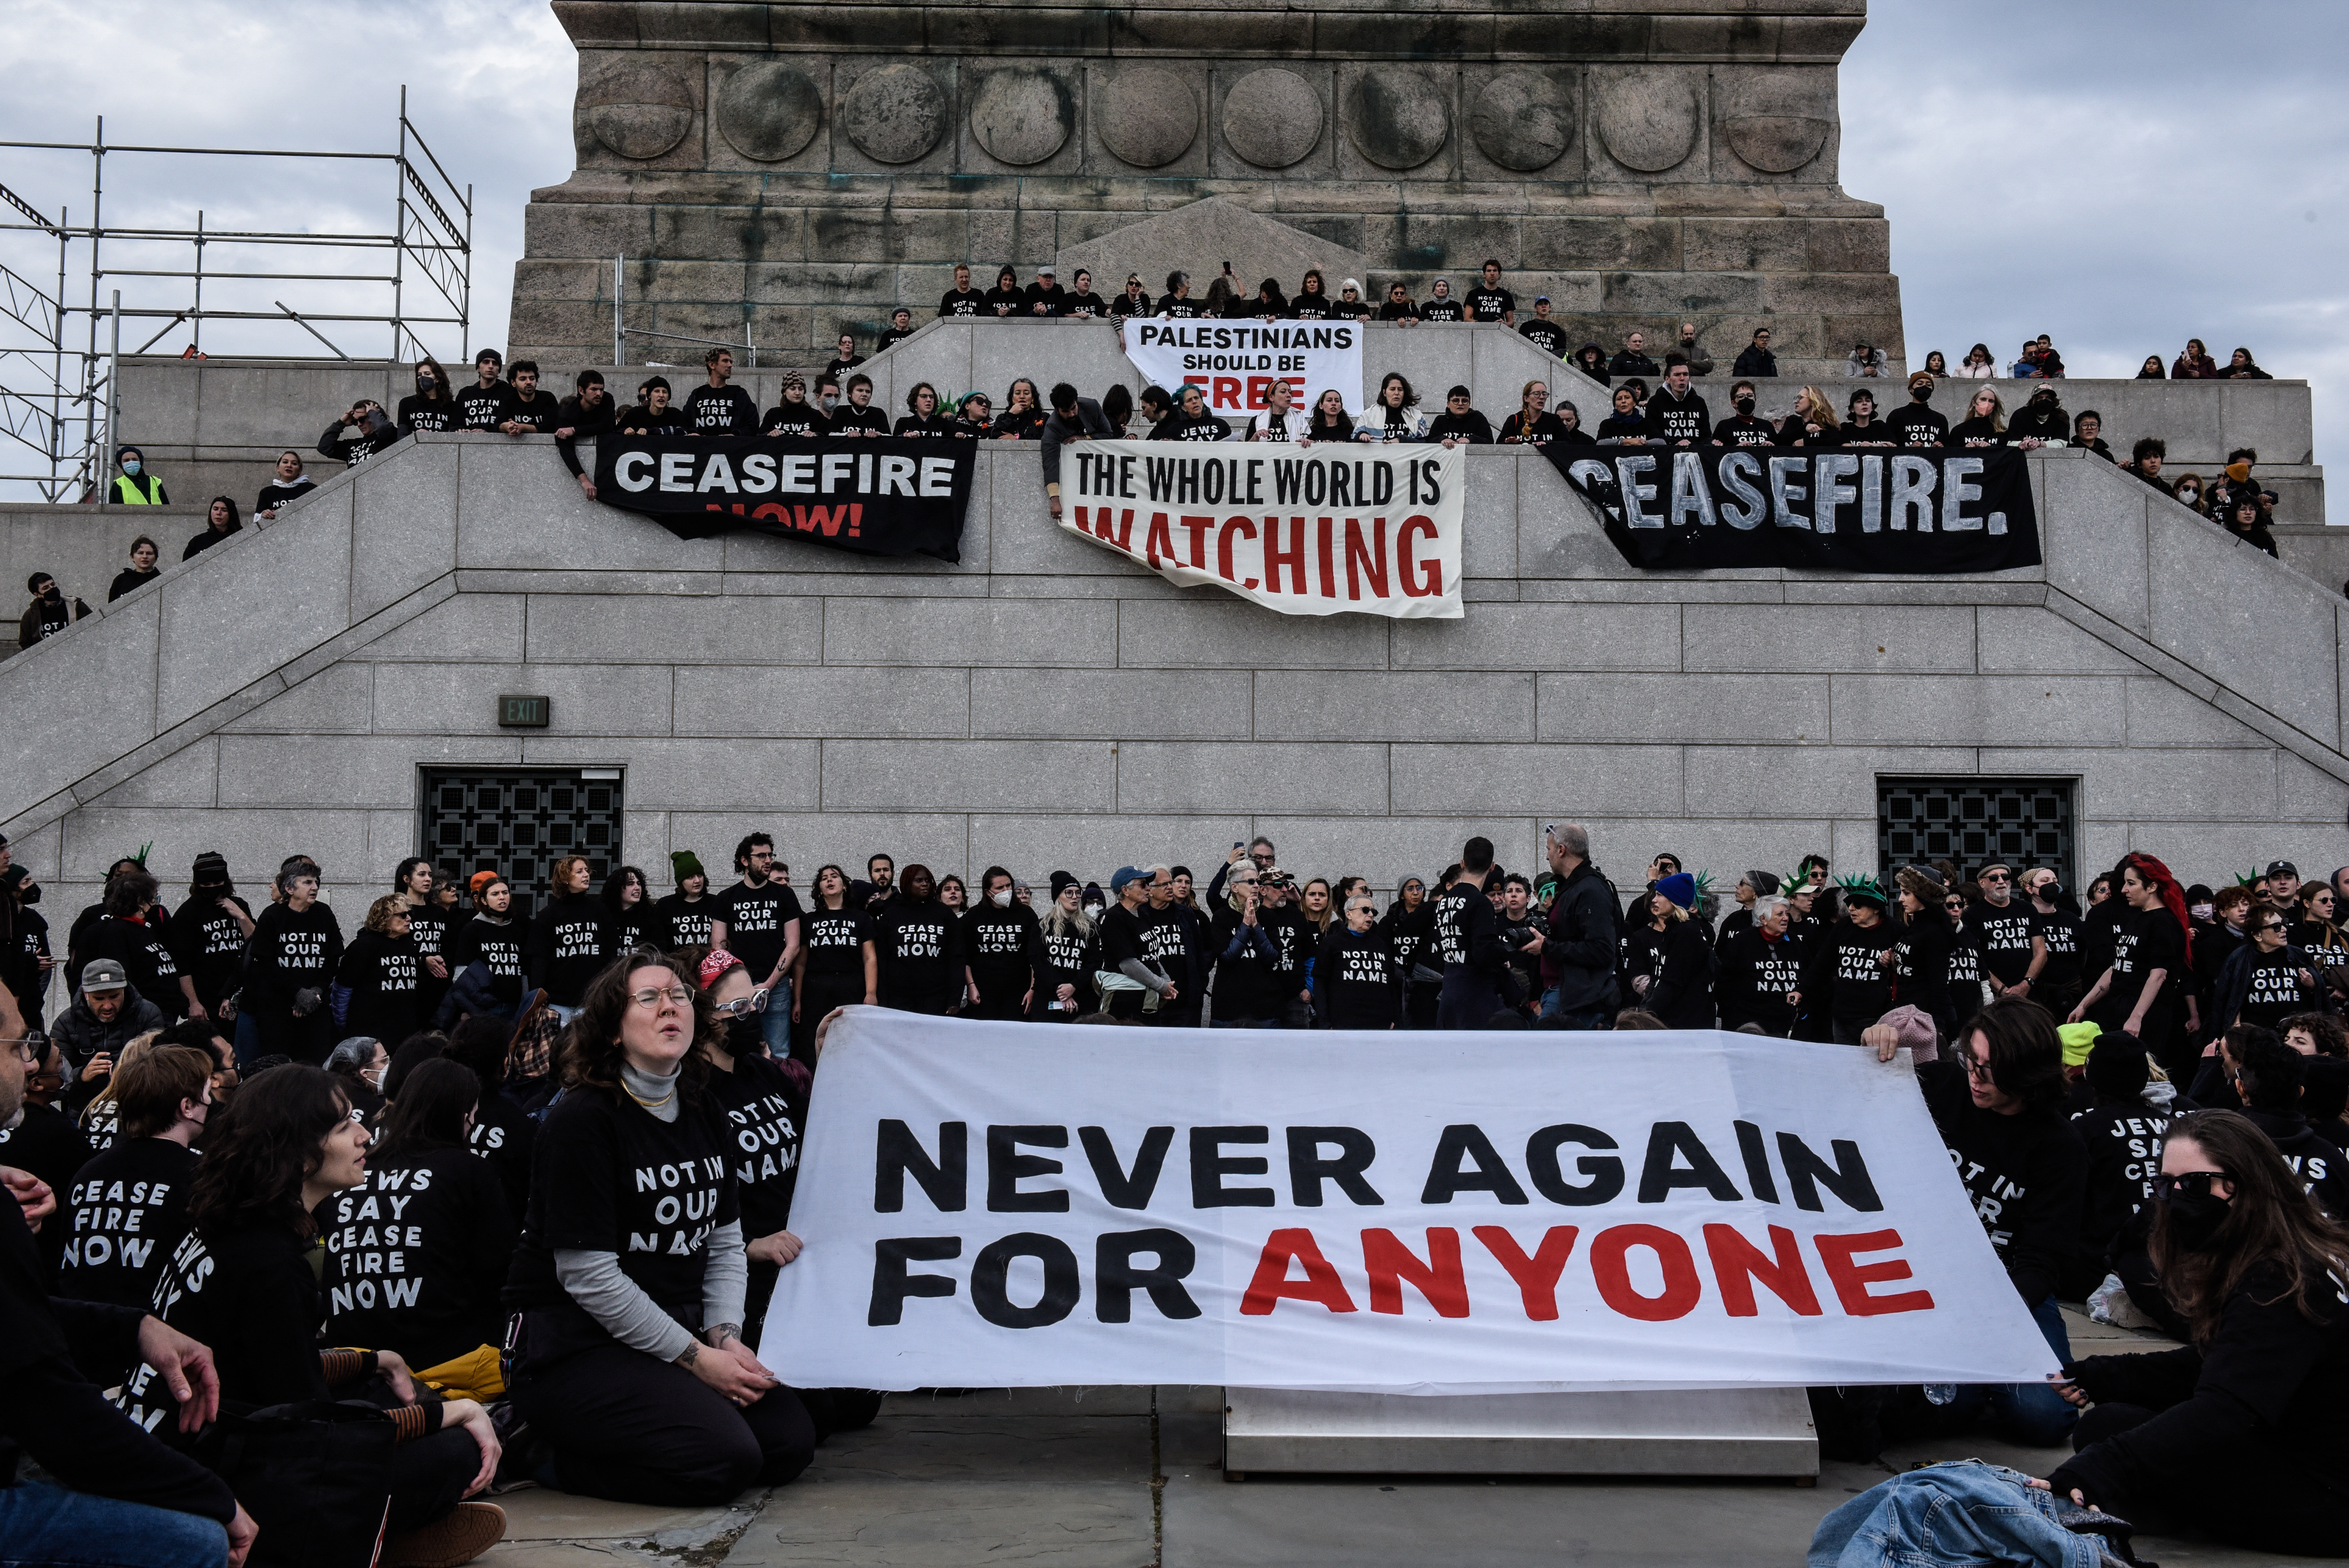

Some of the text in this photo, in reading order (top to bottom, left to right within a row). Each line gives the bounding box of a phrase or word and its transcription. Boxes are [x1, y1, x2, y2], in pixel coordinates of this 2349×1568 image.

[1141, 325, 1352, 349] PALESTINIANS
[1183, 354, 1305, 371] SHOULD BE
[1184, 376, 1305, 410] FREE
[465, 399, 485, 408] NOT
[697, 399, 733, 408] CEASE
[469, 406, 493, 415] OUR
[700, 406, 727, 415] FIRE
[415, 420, 442, 430] OUR
[465, 415, 497, 426] NAME
[696, 415, 732, 427] NOW
[1669, 419, 1696, 427] OUR
[1181, 425, 1218, 439] JEWS
[1665, 428, 1699, 437] NAME
[1930, 426, 1939, 435] IN
[1910, 432, 1935, 442] OUR
[615, 451, 955, 497] CEASEFIRE
[1076, 453, 1441, 507] THE WHOLE WORLD IS
[1075, 507, 1442, 600] WATCHING
[508, 699, 538, 722] EXIT
[733, 901, 759, 911] NOT
[1435, 895, 1466, 914] JEWS
[673, 915, 699, 924] NOT
[739, 909, 771, 920] OUR
[1437, 910, 1457, 929] SAY
[203, 919, 227, 934] NOT
[434, 922, 445, 931] IN
[556, 922, 598, 934] NOT IN
[679, 923, 711, 933] OUR
[734, 920, 777, 931] NAME
[812, 919, 837, 929] NOT
[1983, 918, 2011, 930] NOT
[211, 929, 237, 941] OUR
[413, 931, 441, 941] OUR
[627, 927, 639, 935] IN
[817, 927, 850, 936] OUR
[898, 924, 944, 937] CEASE
[1993, 927, 2026, 939] OUR
[279, 932, 326, 942] NOT IN
[563, 932, 593, 945] OUR
[673, 934, 708, 945] NAM
[810, 936, 857, 948] NAME
[904, 933, 937, 944] FIRE
[983, 933, 1015, 942] FIRE
[1046, 937, 1086, 949] NOT IN
[285, 944, 320, 955] OUR
[481, 942, 505, 951] NOT
[897, 943, 941, 957] NOW
[978, 944, 1021, 953] NOW
[1988, 939, 2030, 950] NAME
[556, 945, 599, 958] NAME
[1049, 945, 1080, 960] OUR
[1156, 945, 1185, 957] AME
[1373, 952, 1385, 961] IN
[1839, 946, 1866, 956] NOT
[1968, 948, 1978, 958] IN
[278, 956, 325, 968] NAME
[381, 955, 407, 966] NOT
[489, 952, 518, 963] OUR
[1841, 956, 1875, 970] OUR
[1350, 960, 1383, 970] OUR
[1755, 961, 1799, 970] NOT IN
[389, 966, 416, 977] OUR
[1343, 970, 1387, 984] NAME
[1764, 970, 1797, 980] OUR
[2283, 967, 2298, 977] IN
[381, 979, 417, 991] NAM
[1758, 981, 1796, 992] NAM
[2254, 977, 2294, 989] OUR
[2248, 990, 2299, 1003] NAME
[762, 1093, 788, 1114] IN
[89, 1116, 118, 1133] SA
[2110, 1118, 2169, 1137] JEW
[737, 1115, 797, 1154] OUR
[874, 1118, 1884, 1213] NEVER AGAIN
[636, 1156, 723, 1192] NOT IN
[1945, 1147, 2025, 1200] OT IN
[71, 1180, 170, 1206] CEASE
[337, 1195, 412, 1223] SAY
[655, 1188, 717, 1226] OUR
[75, 1207, 144, 1232] FIRE
[328, 1225, 421, 1253] CEASE
[62, 1235, 155, 1269] NOW
[341, 1251, 404, 1277] FIRE
[868, 1223, 1935, 1329] FOR ANYONE
[331, 1277, 423, 1315] NOW
